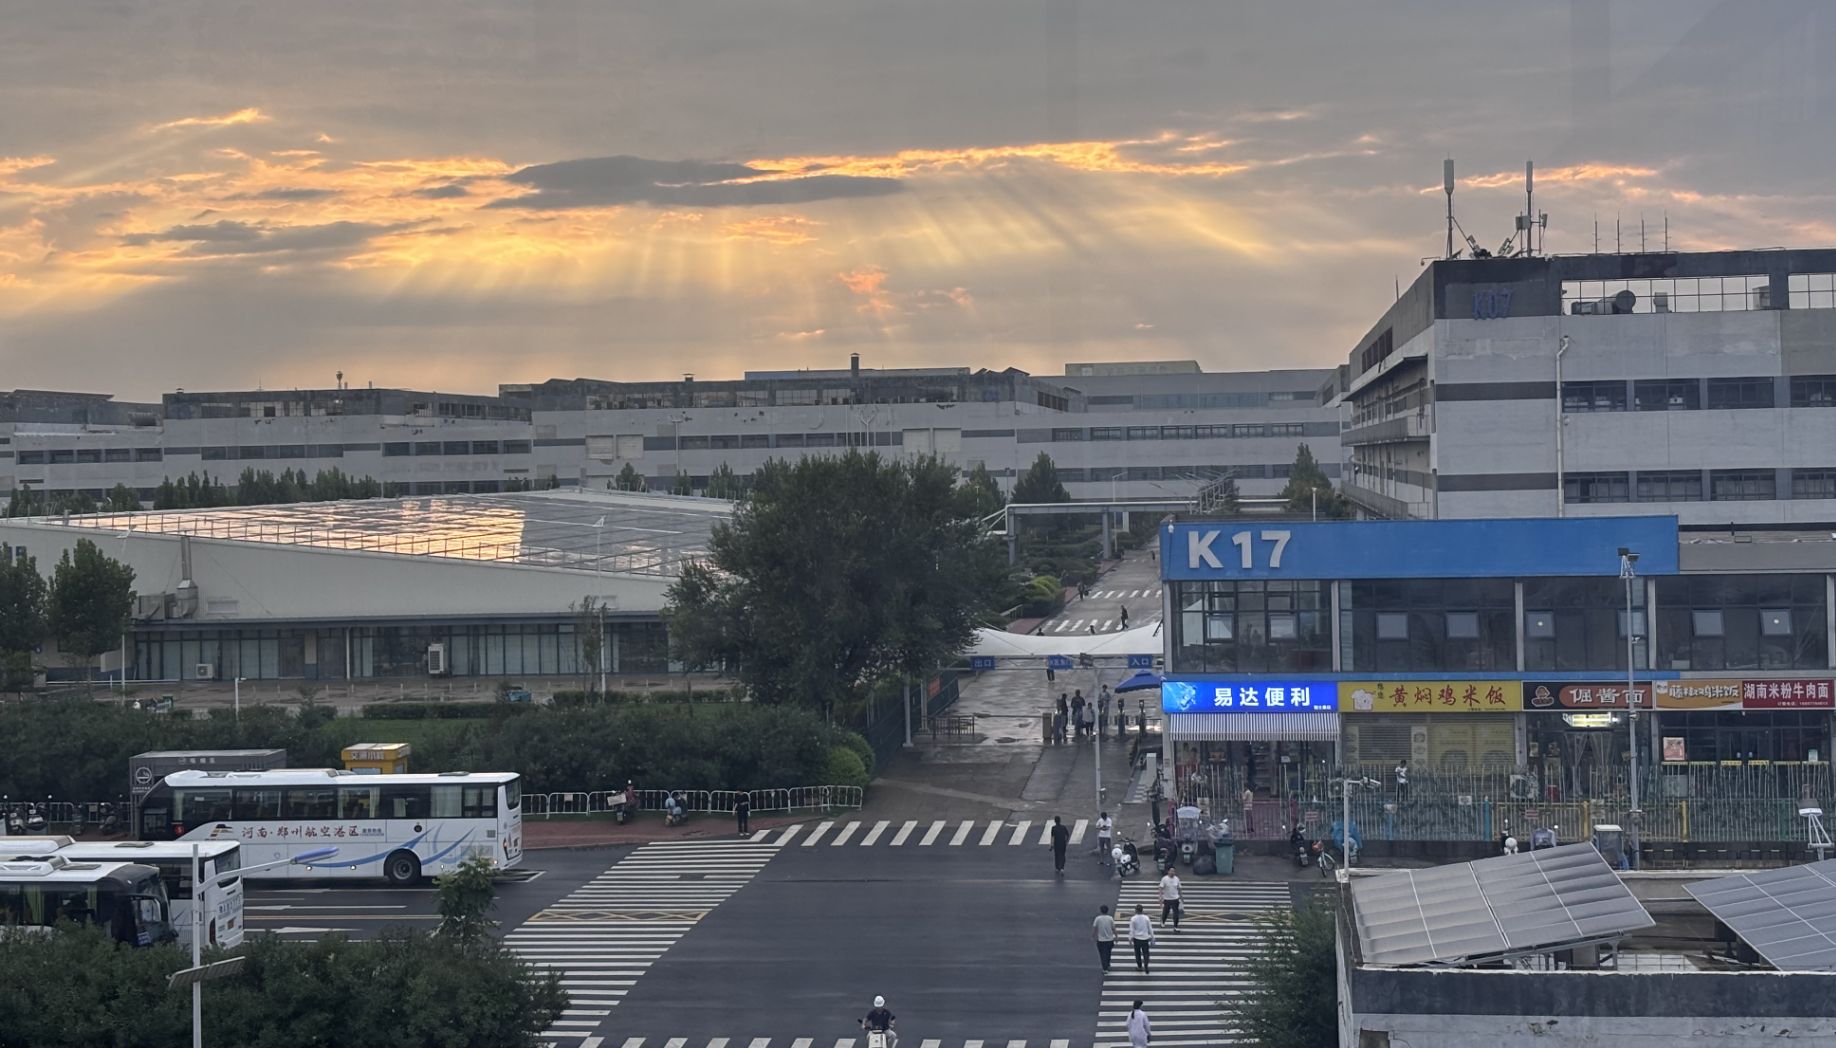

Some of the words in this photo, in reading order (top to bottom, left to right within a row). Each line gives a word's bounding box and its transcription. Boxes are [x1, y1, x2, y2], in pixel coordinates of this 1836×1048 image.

[1188, 530, 1291, 568] K17
[974, 659, 992, 668] 出口
[1131, 658, 1149, 666] 入口
[1214, 687, 1310, 706] 易达便利
[1390, 684, 1506, 707] 黄焖鸡米饭
[1669, 685, 1740, 700] 藤椒鸡米饭
[1744, 682, 1829, 699] 湖南米粉牛肉面
[242, 825, 359, 840] 河南·郑州航空港区
